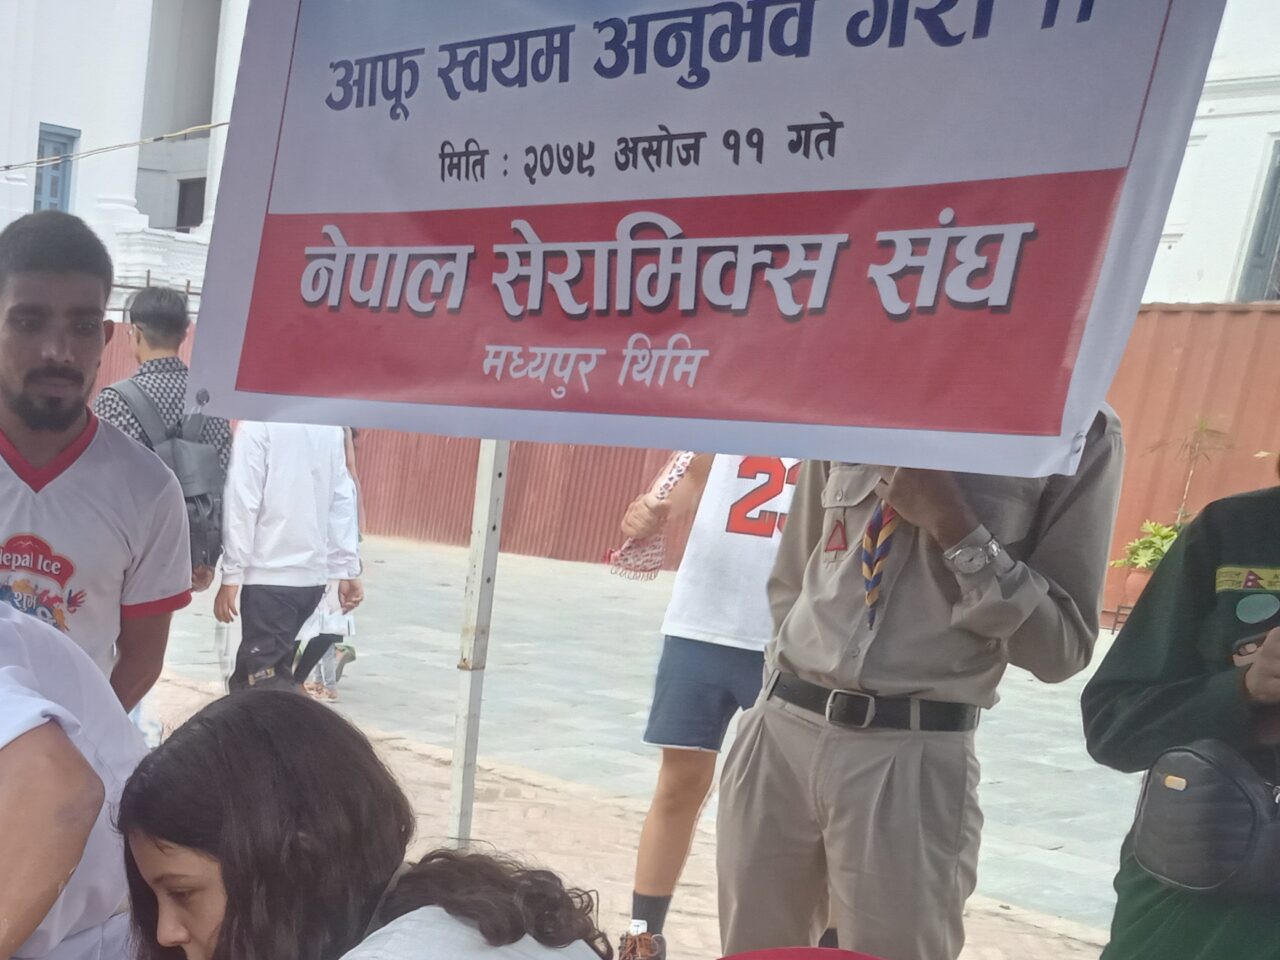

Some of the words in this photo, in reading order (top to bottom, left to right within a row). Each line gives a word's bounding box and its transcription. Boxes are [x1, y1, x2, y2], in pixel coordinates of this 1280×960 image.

[324, 47, 426, 122] आफू
[436, 23, 576, 102] स्वयम
[592, 0, 816, 90] अनुभव
[438, 137, 490, 183] मिति
[523, 139, 595, 185] २०७९
[614, 124, 708, 173] असोज
[722, 127, 765, 166] ११
[786, 112, 845, 161] गते
[300, 224, 475, 314] नेपाल
[491, 211, 848, 317] सेरामिक्स
[867, 206, 1037, 316] संघ
[482, 344, 607, 399] मध्यपुर
[617, 332, 710, 389] थिमि
[725, 455, 801, 539] 2
[36, 552, 62, 575] Ice
